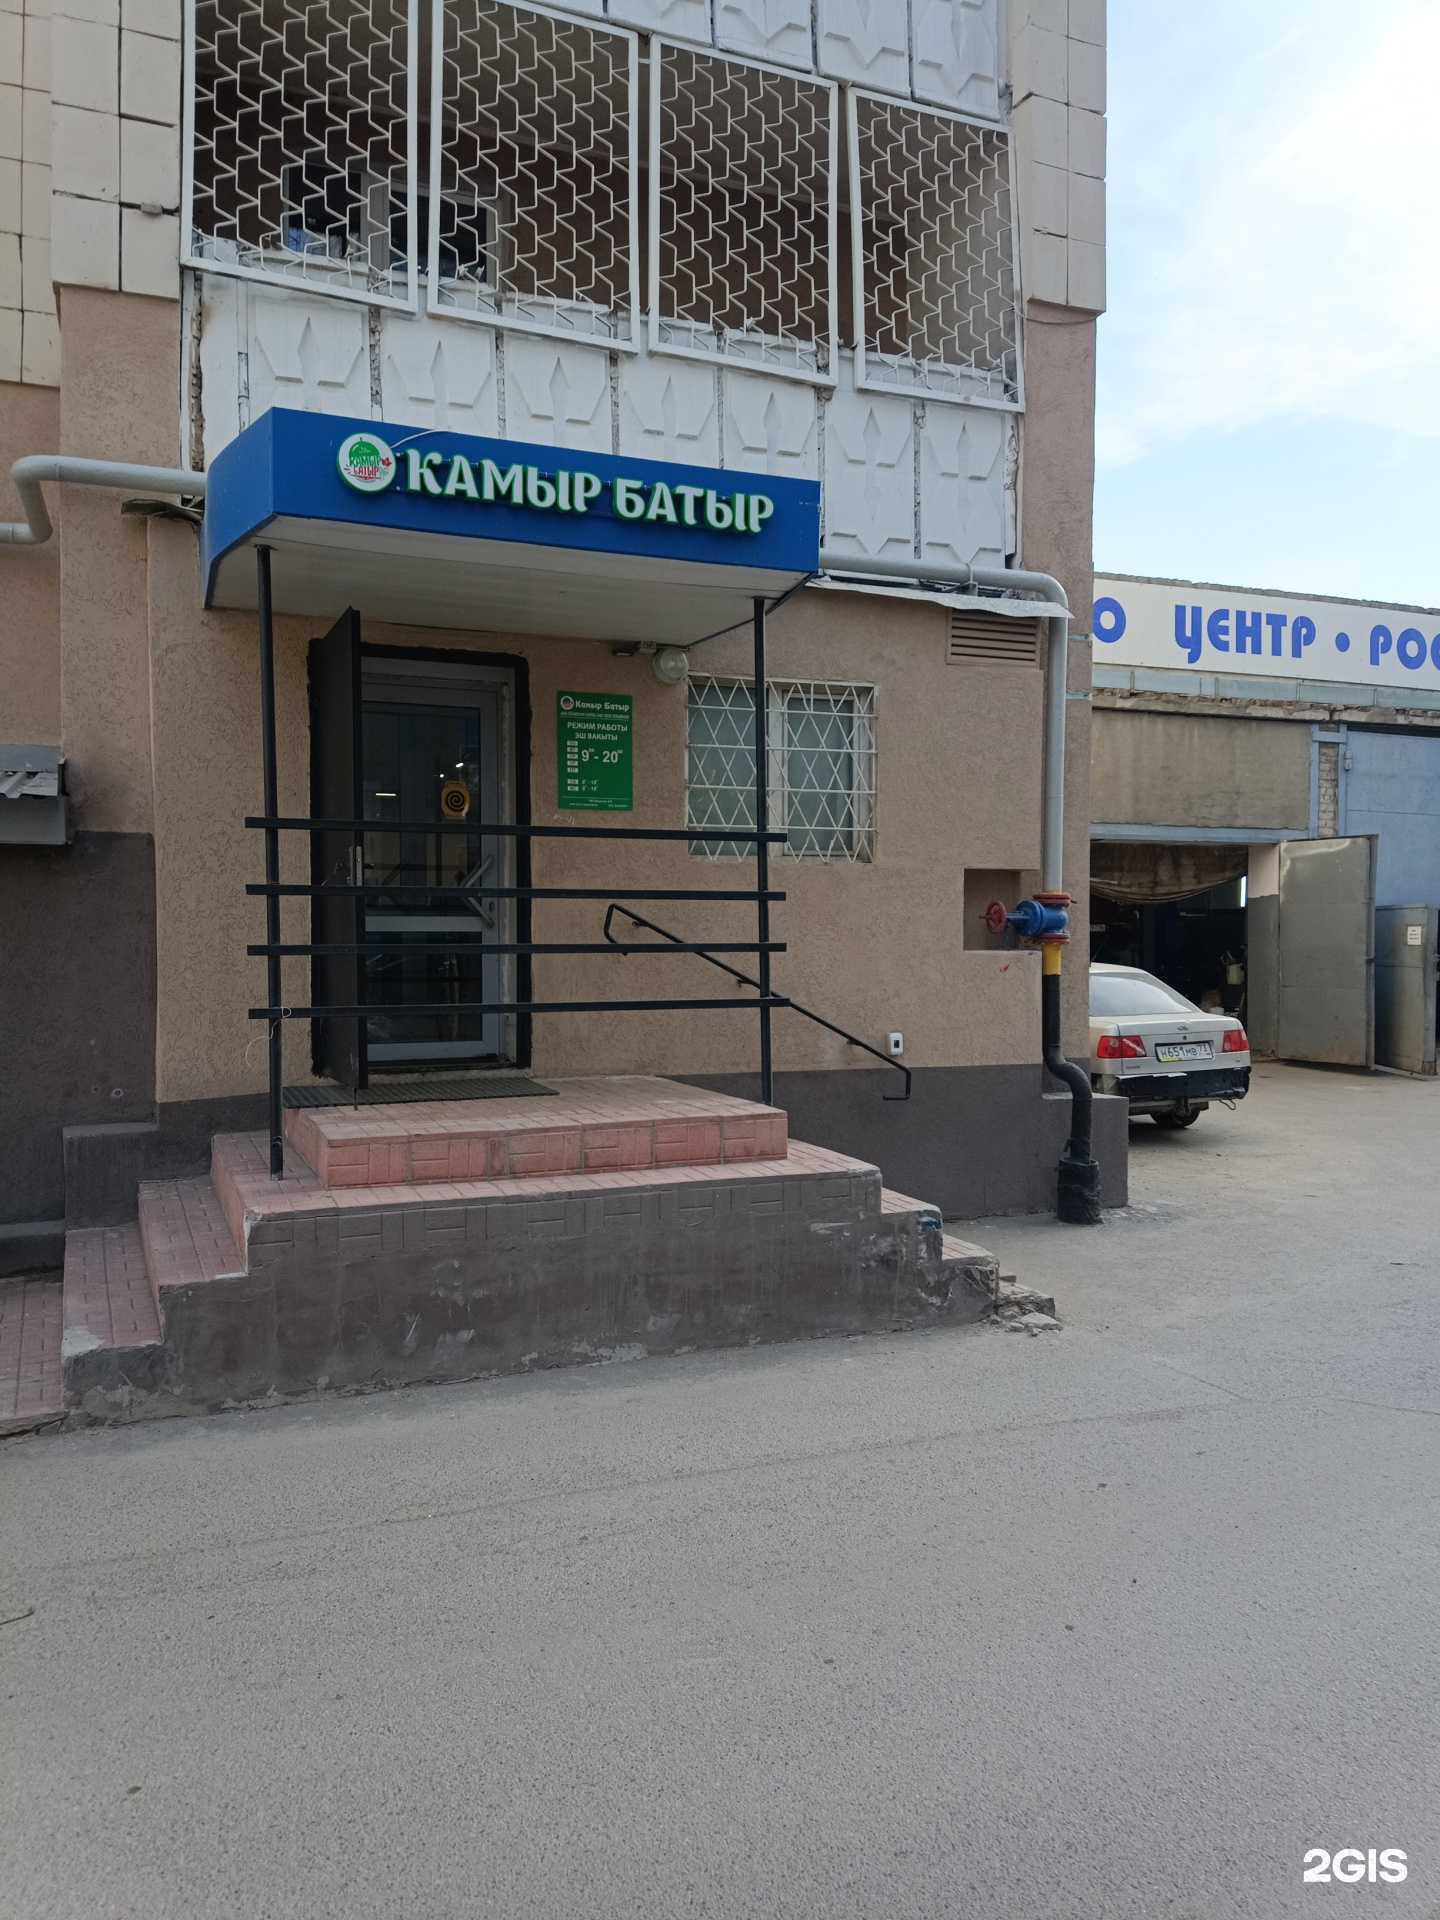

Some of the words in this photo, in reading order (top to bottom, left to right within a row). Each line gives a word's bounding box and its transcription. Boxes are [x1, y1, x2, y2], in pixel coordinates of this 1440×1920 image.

[406, 448, 602, 513] КАМЫР
[614, 477, 775, 533] БАТЫР
[1174, 604, 1316, 664] ЦЕНТР
